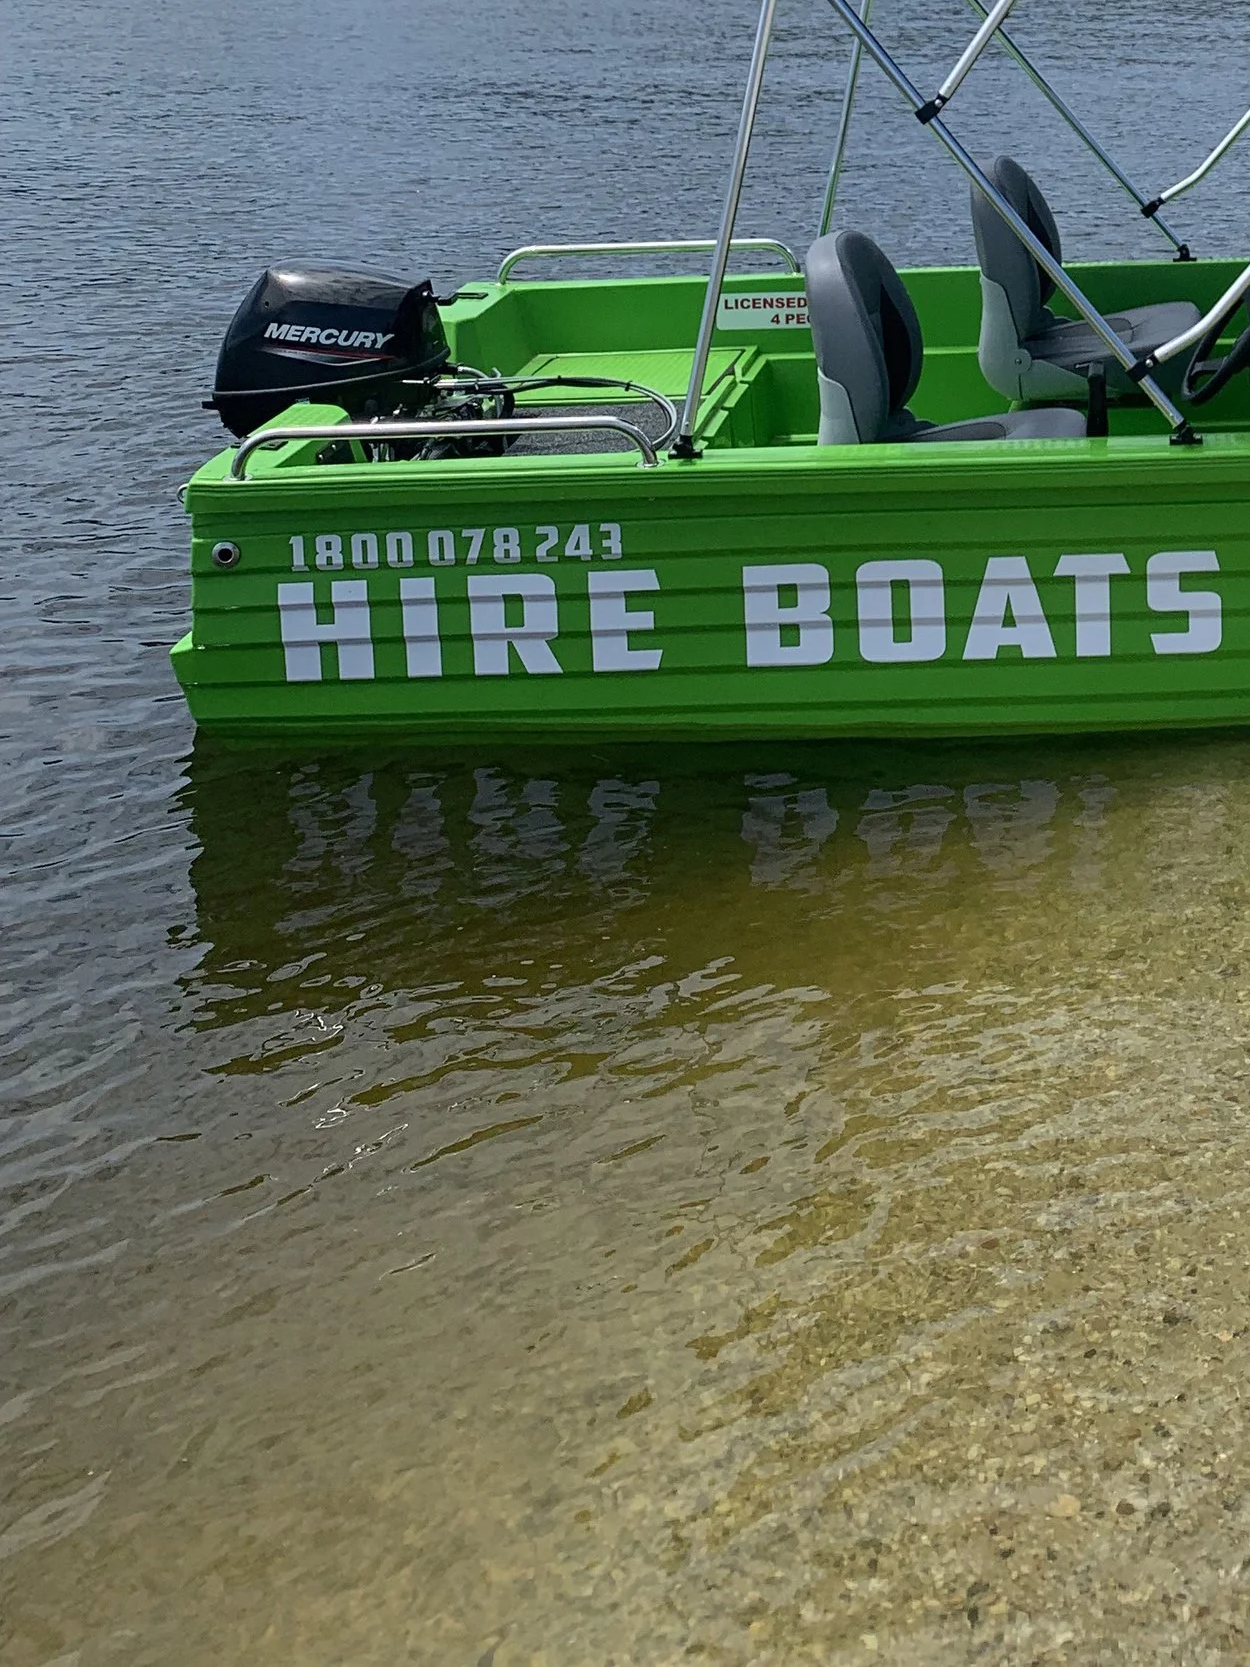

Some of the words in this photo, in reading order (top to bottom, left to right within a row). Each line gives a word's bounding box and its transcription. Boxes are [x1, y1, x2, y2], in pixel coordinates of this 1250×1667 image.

[724, 297, 808, 310] LICENSED
[770, 313, 781, 325] 4
[785, 313, 811, 325] PE
[263, 322, 396, 349] MERCURY
[288, 531, 415, 572] 1800
[427, 527, 522, 567] 078
[535, 522, 623, 563] 243
[277, 568, 664, 683] HIRE
[741, 549, 1224, 668] BOATS
